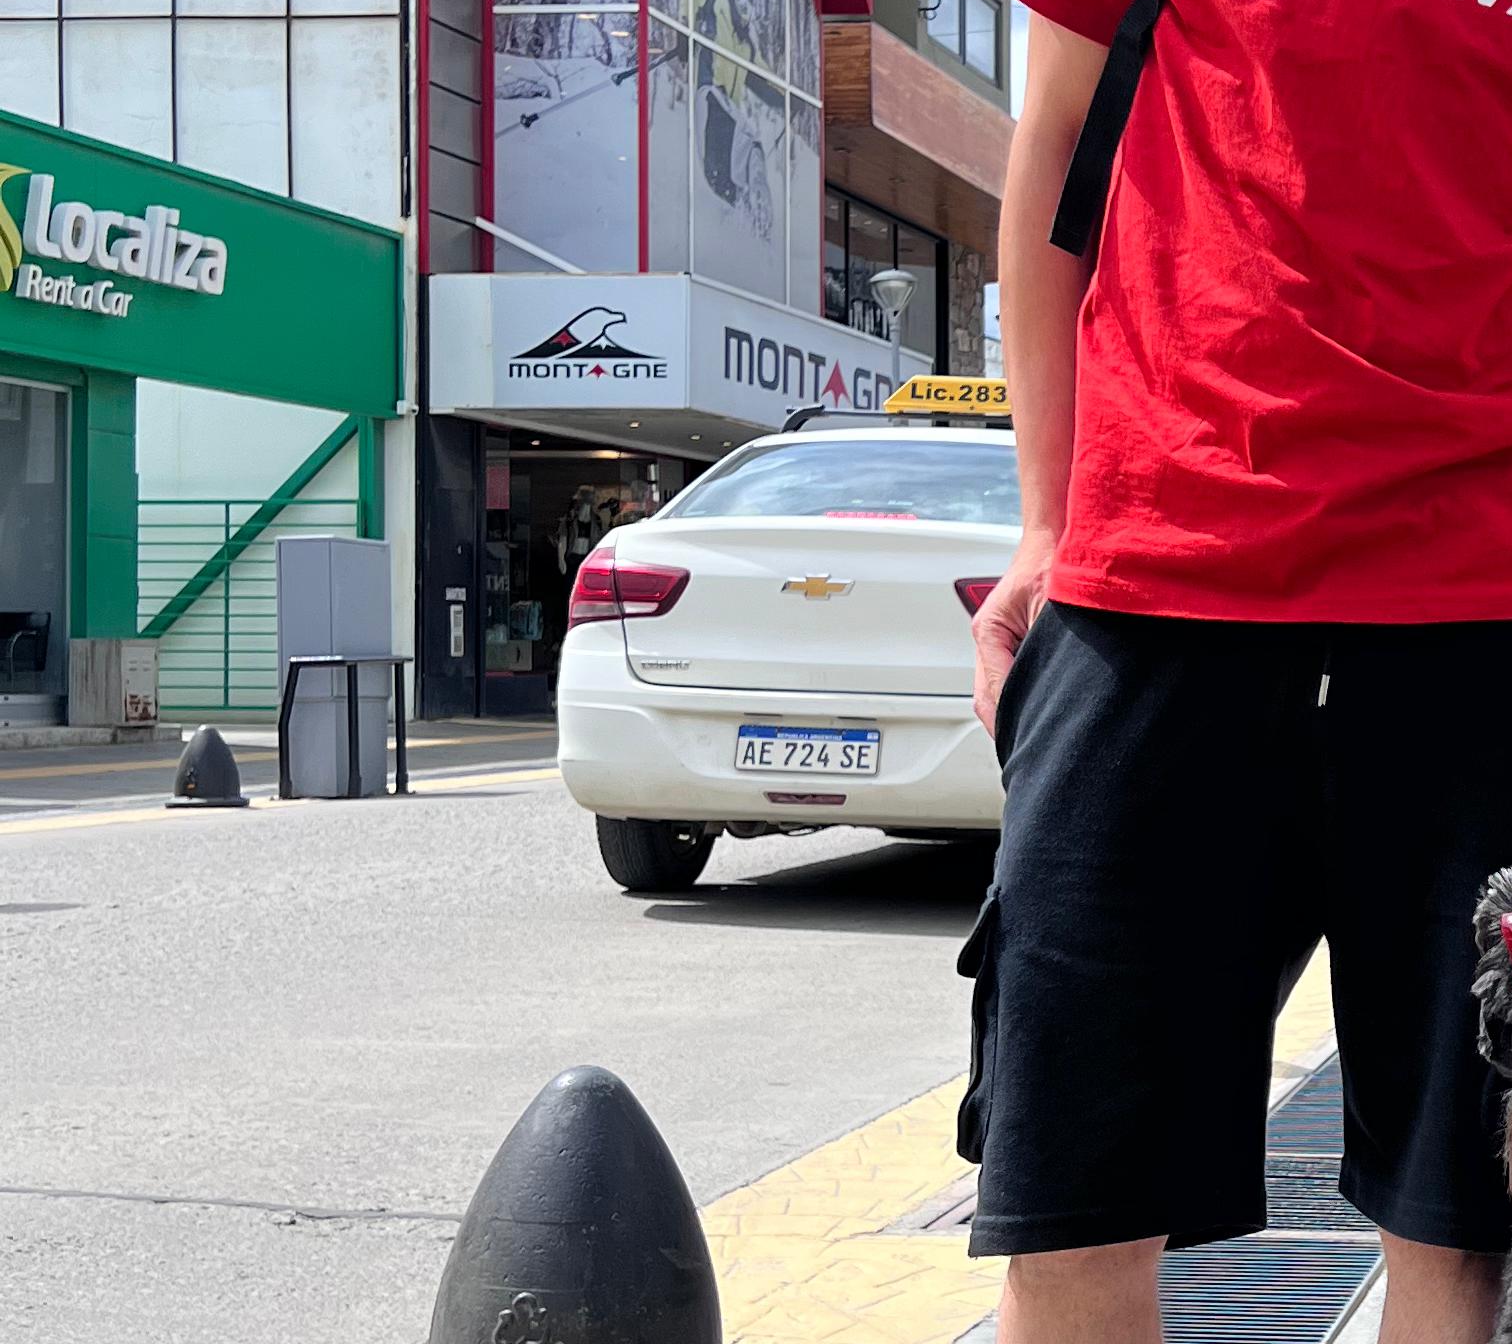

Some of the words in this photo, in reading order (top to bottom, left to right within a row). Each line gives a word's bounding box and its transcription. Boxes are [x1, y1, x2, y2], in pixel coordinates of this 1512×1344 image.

[23, 173, 228, 295] Localiza
[16, 263, 76, 306] Rent
[92, 280, 134, 318] Car
[742, 740, 774, 766] AE
[783, 742, 830, 768] 724
[839, 744, 871, 769] SE
